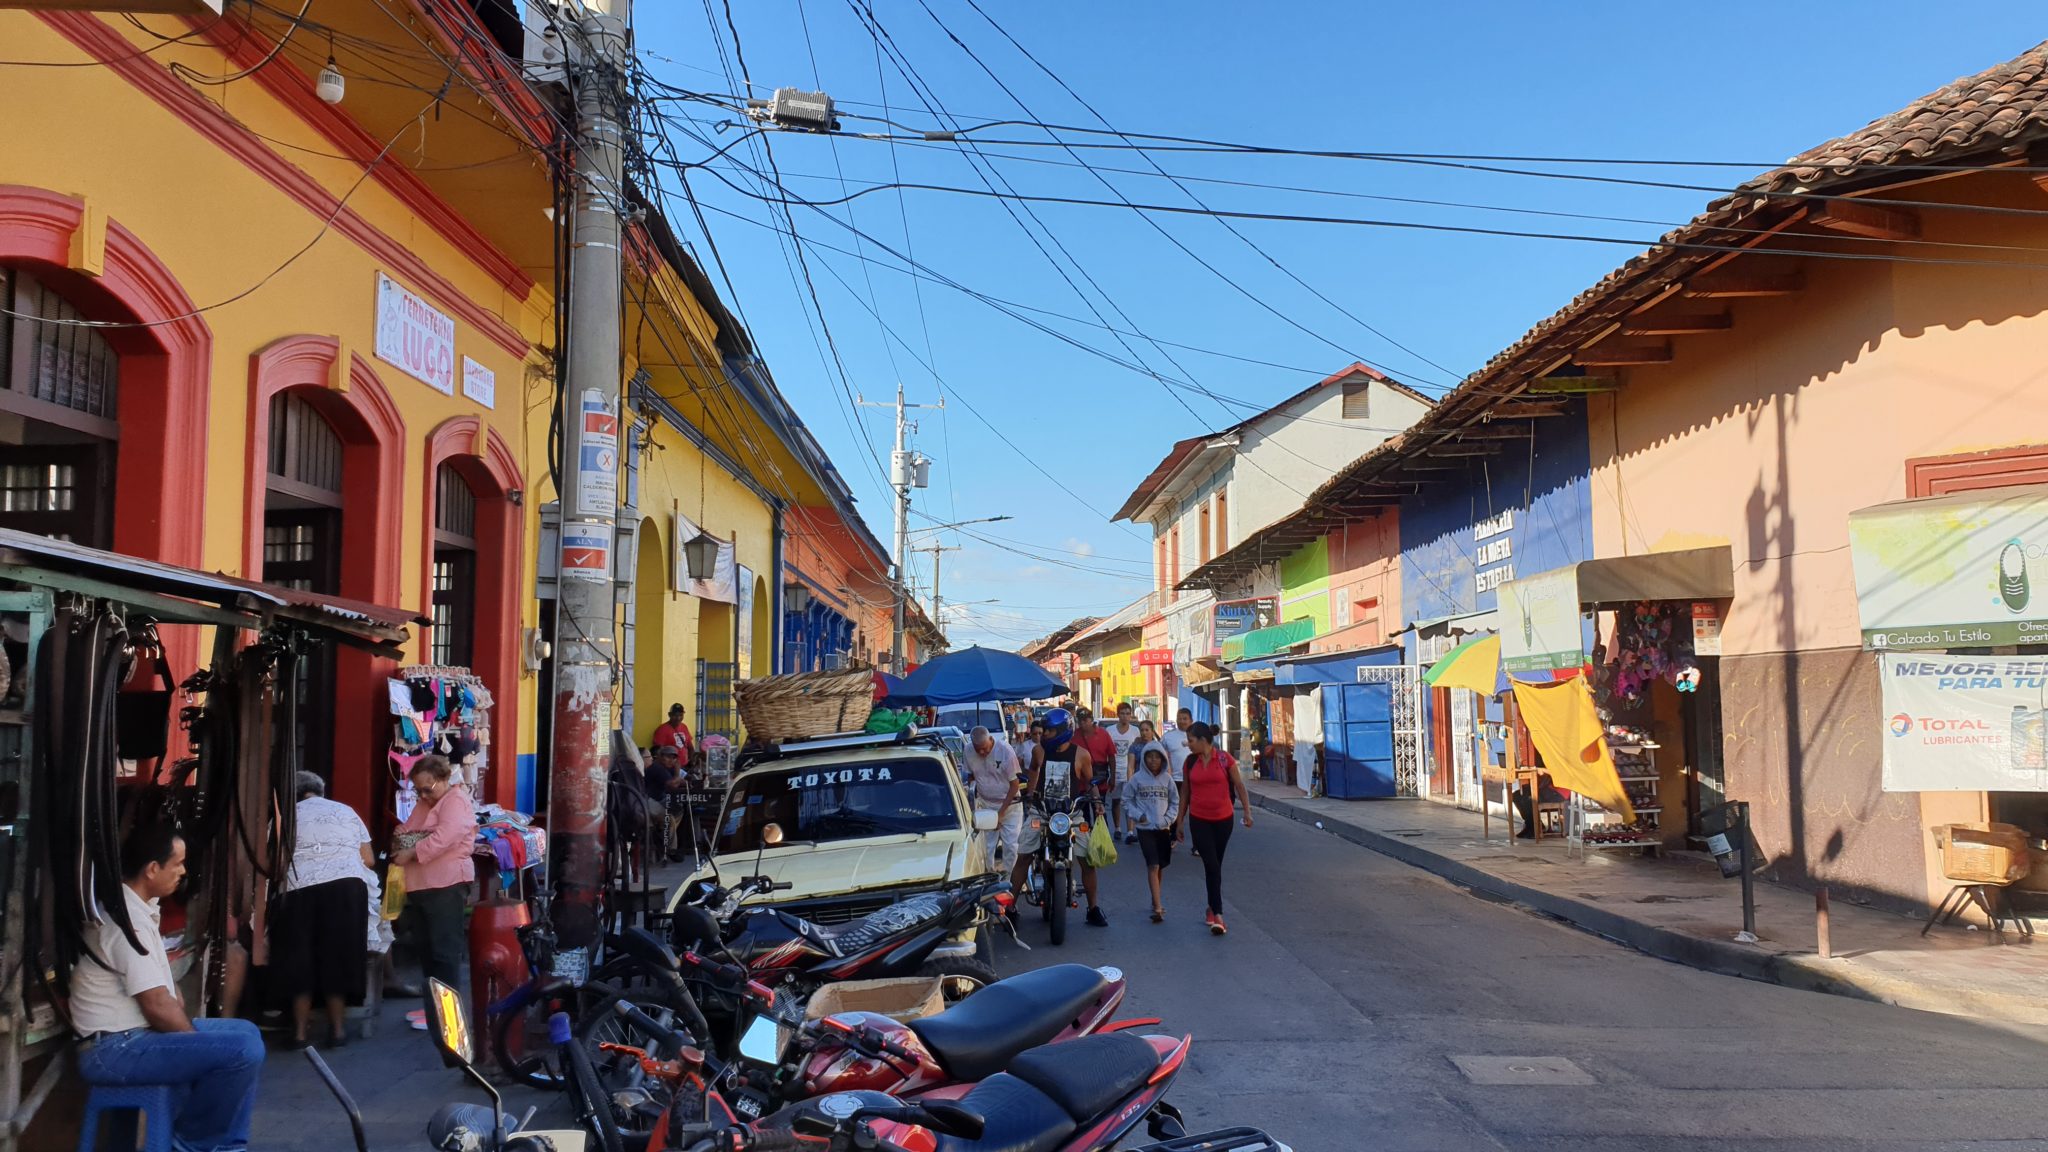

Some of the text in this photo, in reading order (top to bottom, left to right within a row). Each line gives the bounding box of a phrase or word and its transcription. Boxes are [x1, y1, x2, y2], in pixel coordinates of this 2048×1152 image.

[402, 320, 453, 387] LUGO
[1476, 545, 1489, 567] LA
[1887, 628, 1991, 645] Calzado Tu Estilo
[1895, 662, 1997, 676] MEJOR
[1938, 677, 2047, 690] PARA TU
[1923, 735, 2002, 745] LUBRICANTES
[787, 767, 892, 791] TOYOTA
